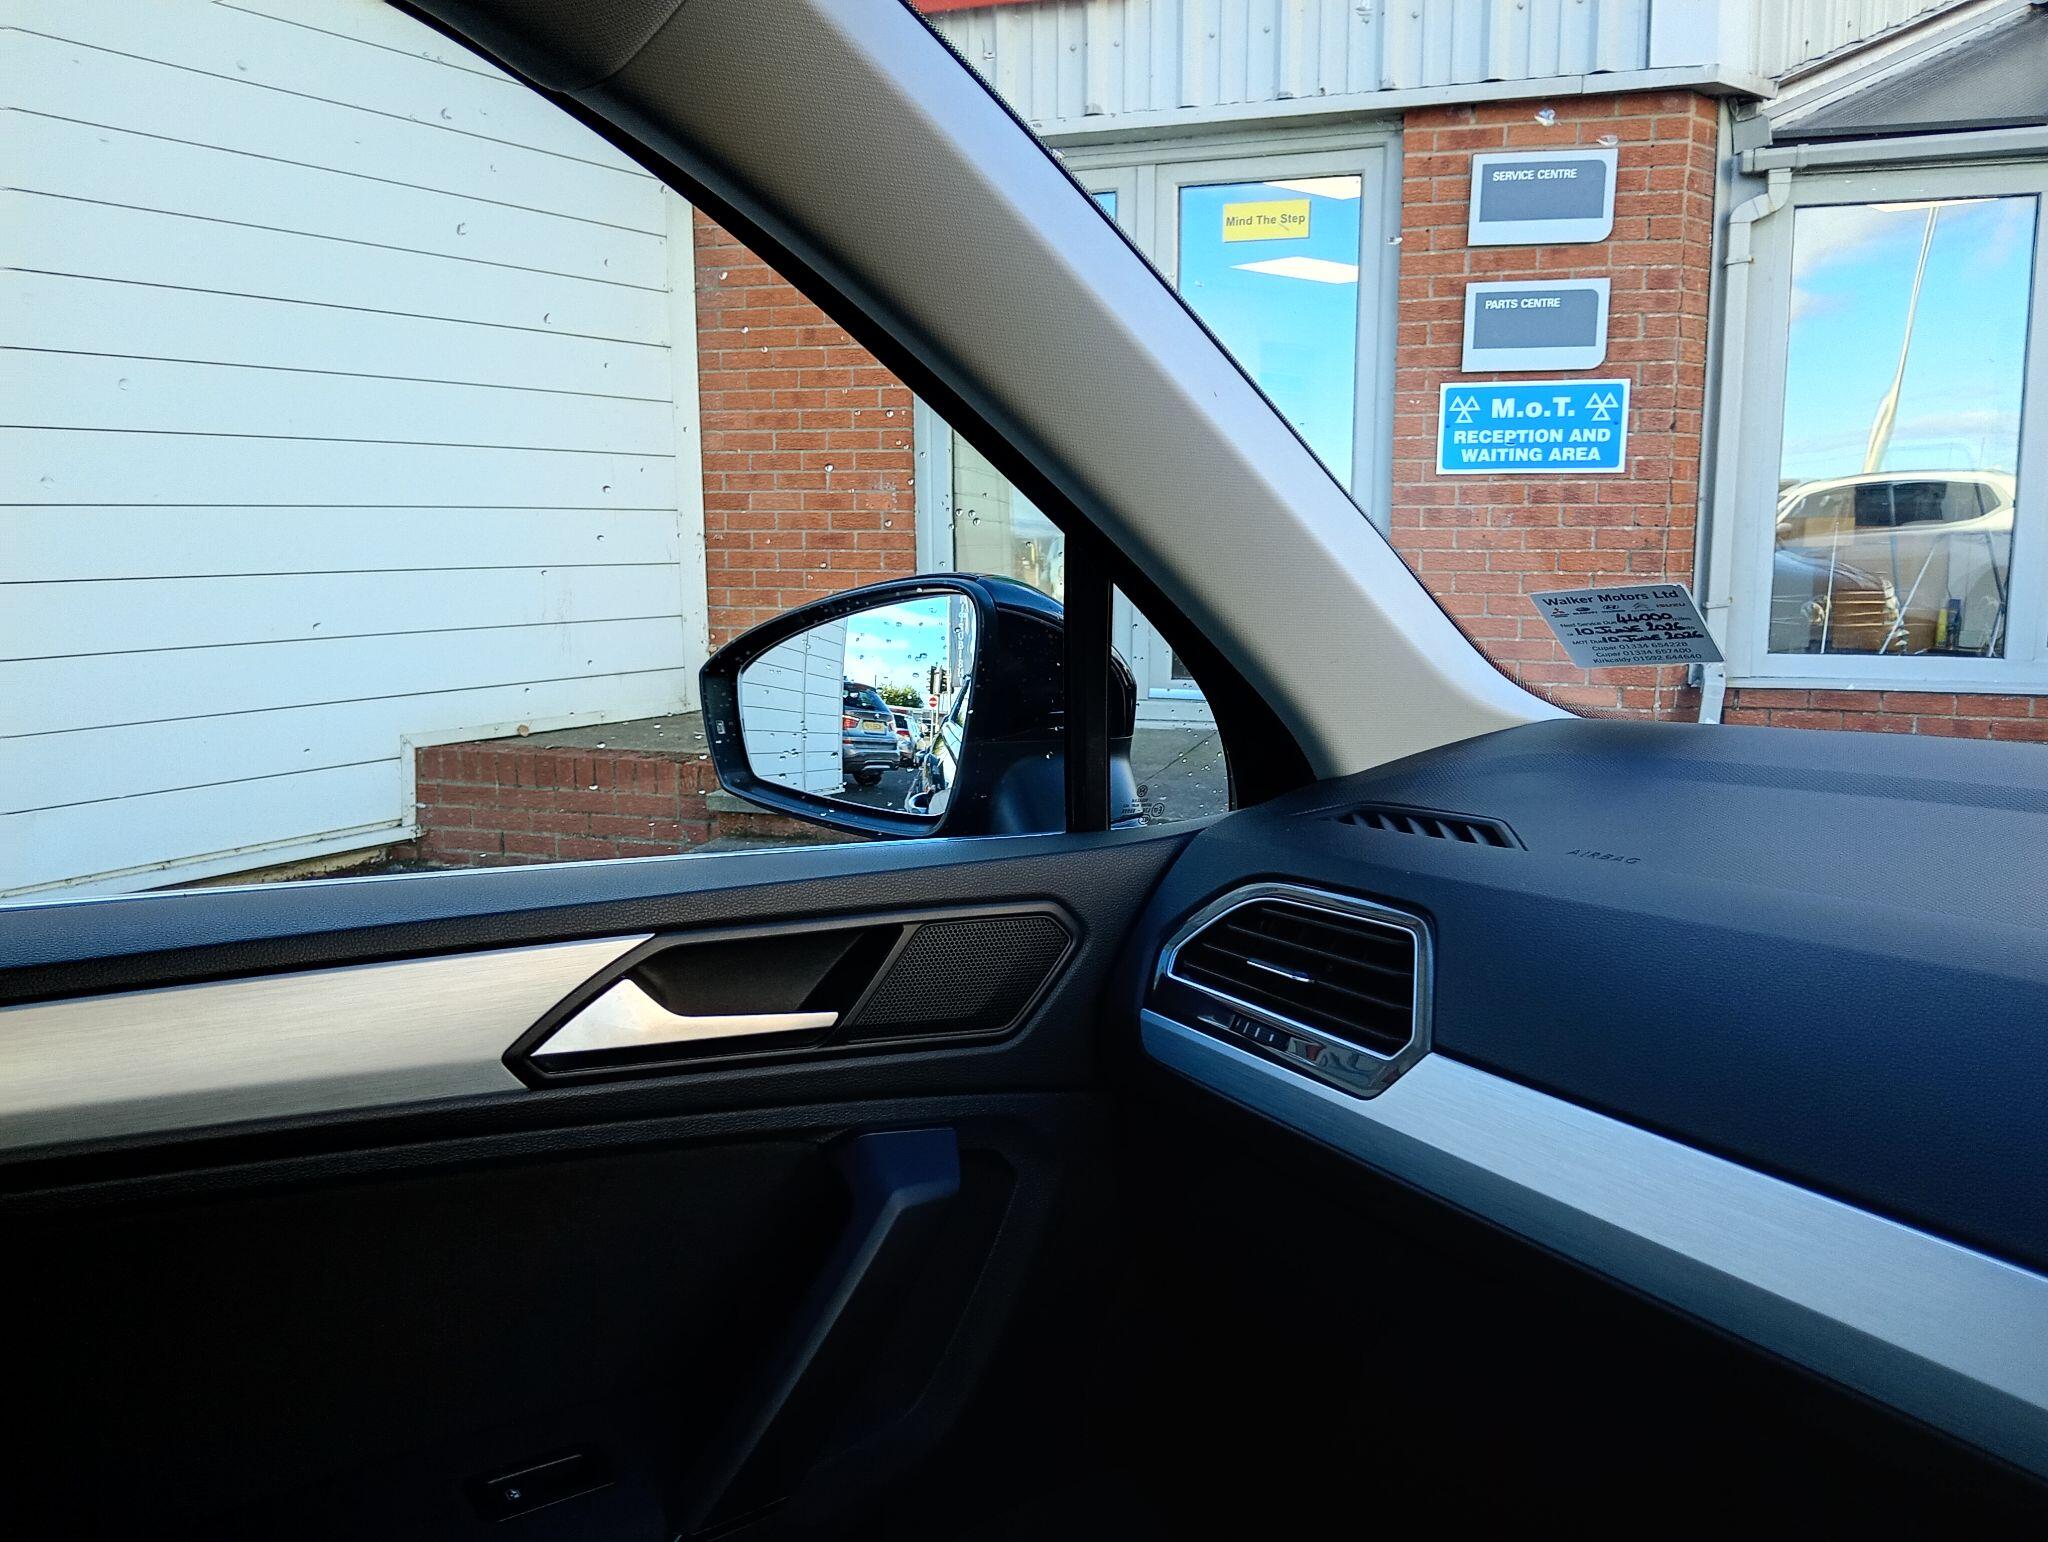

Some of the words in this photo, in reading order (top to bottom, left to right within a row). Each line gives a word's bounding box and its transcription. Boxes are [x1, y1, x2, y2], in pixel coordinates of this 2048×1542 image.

[1493, 170, 1535, 182] SERVICE
[1537, 168, 1578, 180] CENTRE
[1226, 216, 1253, 227] Mind
[1256, 215, 1277, 225] The
[1280, 213, 1306, 225] Step
[1485, 300, 1518, 310] PARTS
[1520, 298, 1561, 308] CENTRE
[1491, 396, 1576, 419] M.o.T.
[1453, 430, 1563, 444] RECEPTION
[1568, 428, 1611, 443] AND
[1461, 449, 1543, 463] WAITING
[1548, 446, 1601, 462] AREA
[1542, 596, 1593, 606] Walker
[1597, 592, 1649, 602] Motors
[1653, 590, 1679, 599] Ltd
[1566, 849, 1641, 864] AIRBAG
